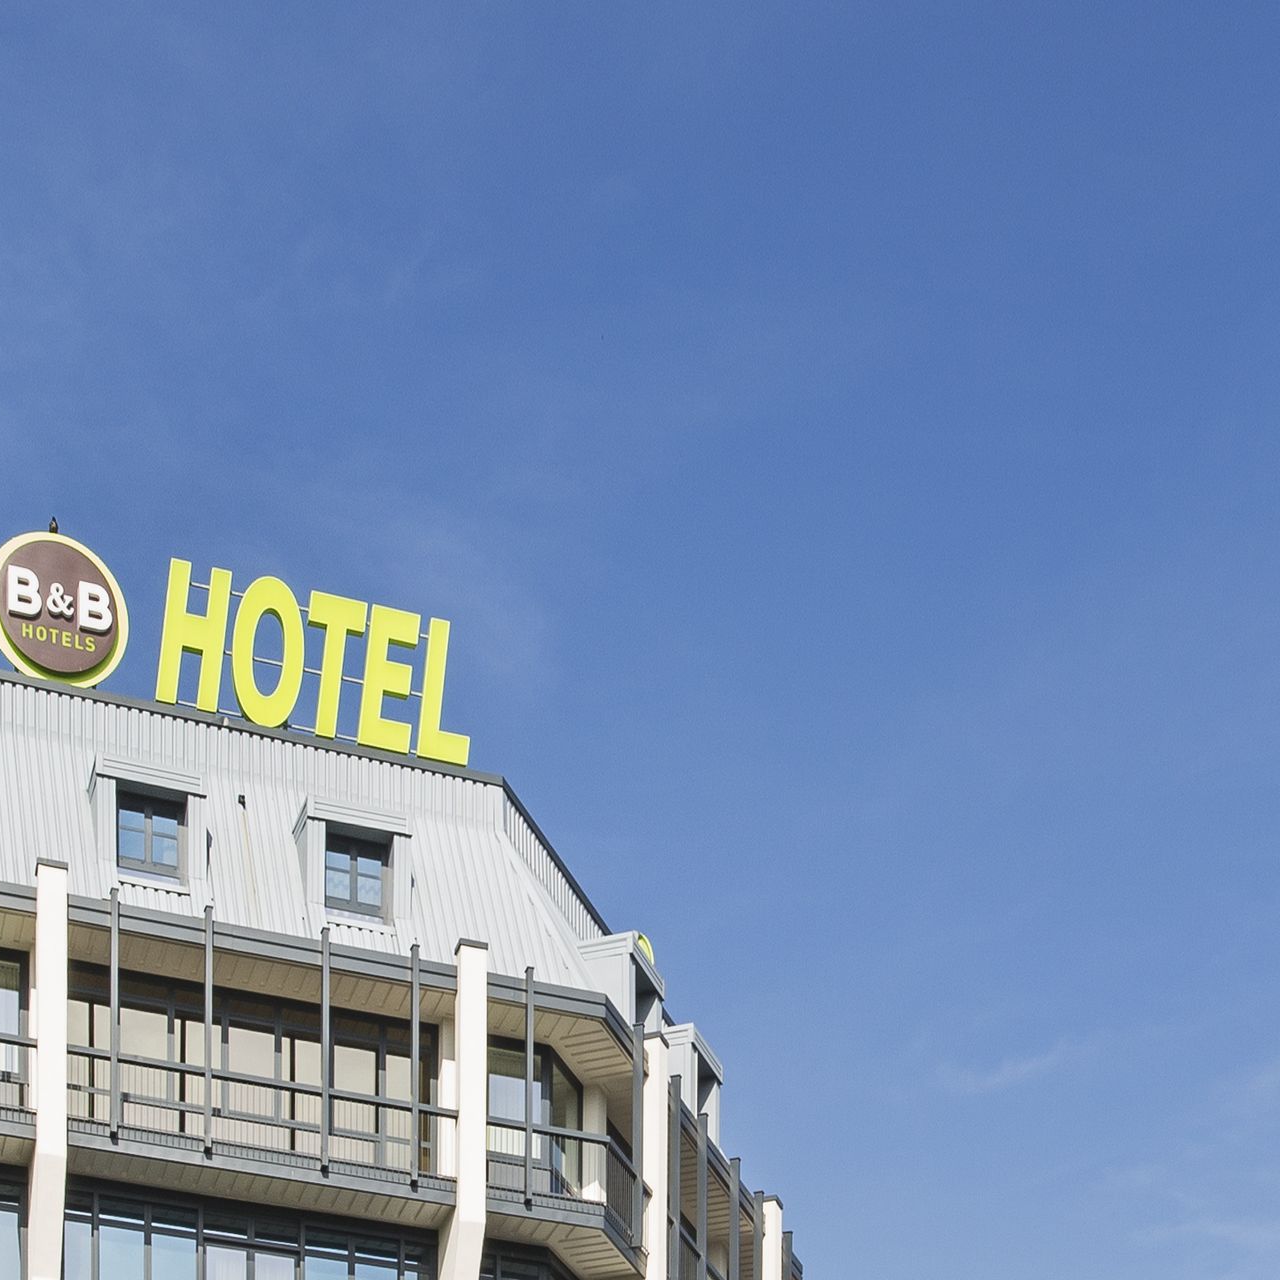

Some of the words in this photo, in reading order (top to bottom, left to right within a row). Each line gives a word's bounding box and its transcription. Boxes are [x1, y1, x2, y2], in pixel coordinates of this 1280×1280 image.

[7, 564, 113, 634] B&B
[21, 622, 96, 653] HOTELS
[156, 557, 470, 766] HOTEL
